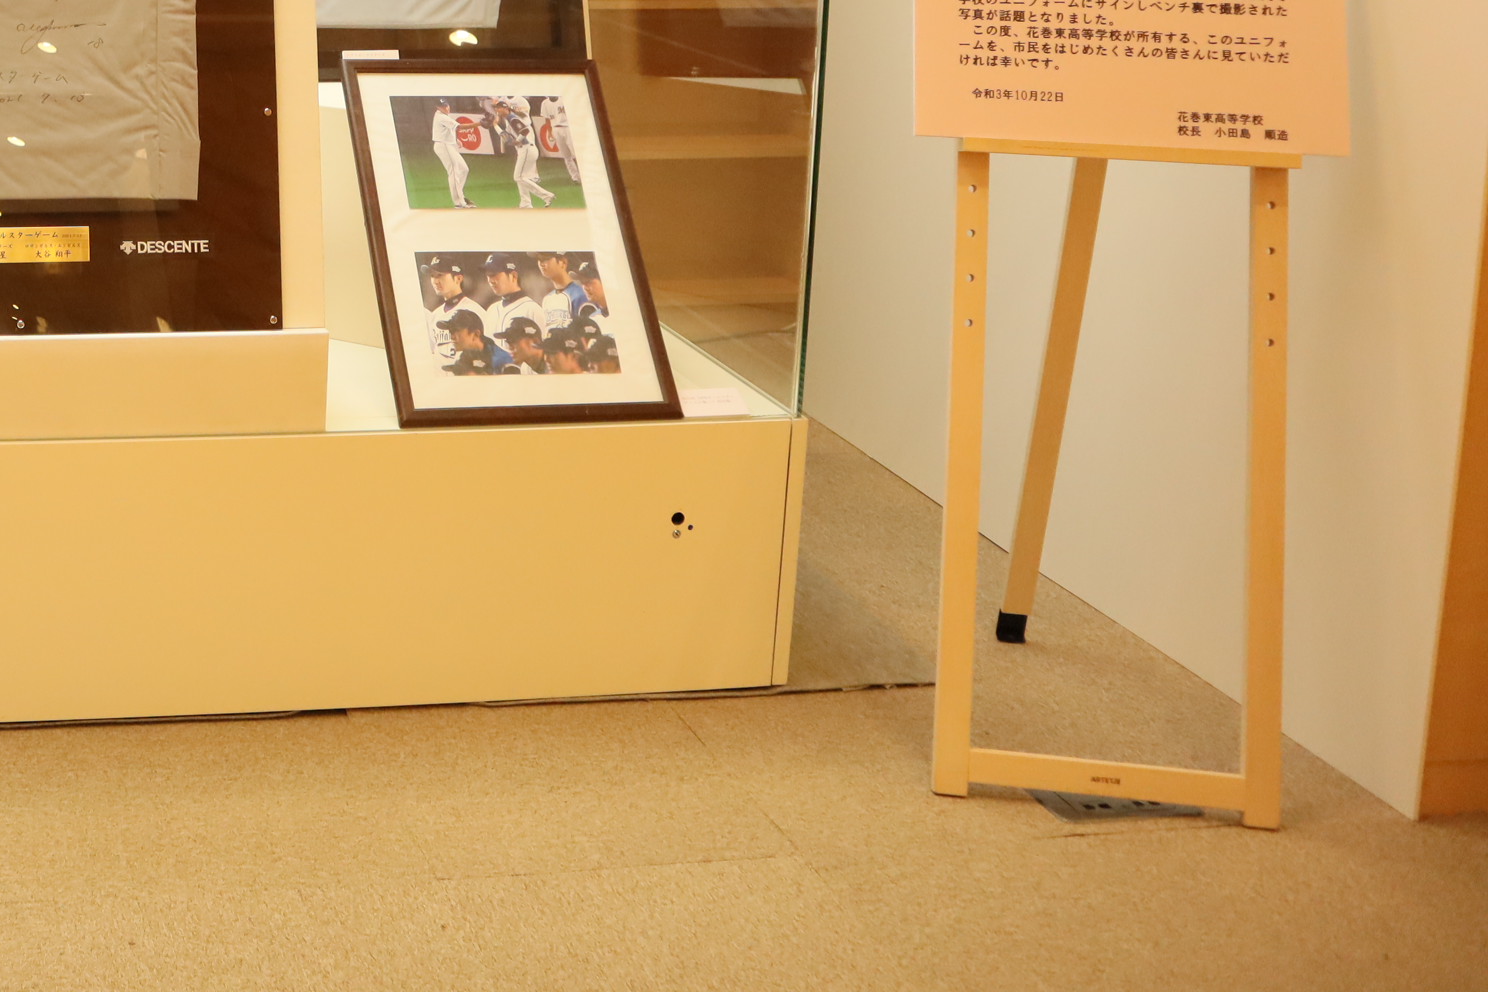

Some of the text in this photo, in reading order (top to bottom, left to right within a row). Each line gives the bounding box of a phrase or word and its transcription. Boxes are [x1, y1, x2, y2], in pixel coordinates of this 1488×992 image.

[959, 8, 1114, 26] 写真が話題となりました。
[959, 54, 1060, 70] ければ幸いです。
[972, 88, 1064, 102] 令和3年10月22日
[1177, 111, 1264, 126] 花巻東高等学校
[1177, 125, 1202, 137] 校長
[137, 239, 209, 254] DESCENTE
